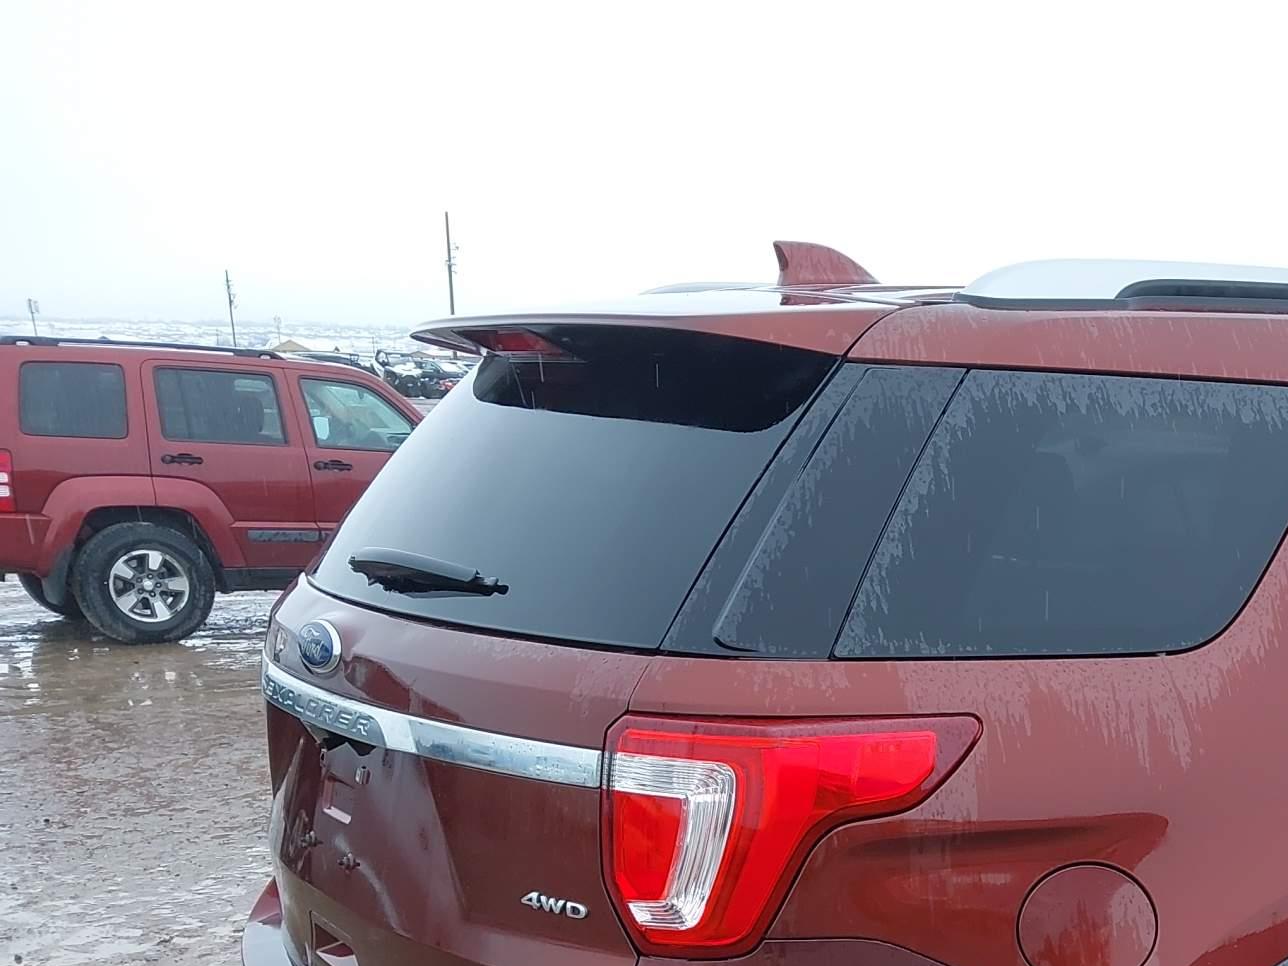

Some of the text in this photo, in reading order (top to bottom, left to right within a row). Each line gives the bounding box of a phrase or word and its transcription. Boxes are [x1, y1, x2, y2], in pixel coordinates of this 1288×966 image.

[301, 627, 326, 658] Ford
[264, 676, 371, 736] EXPLORER
[520, 891, 588, 919] 4WD
